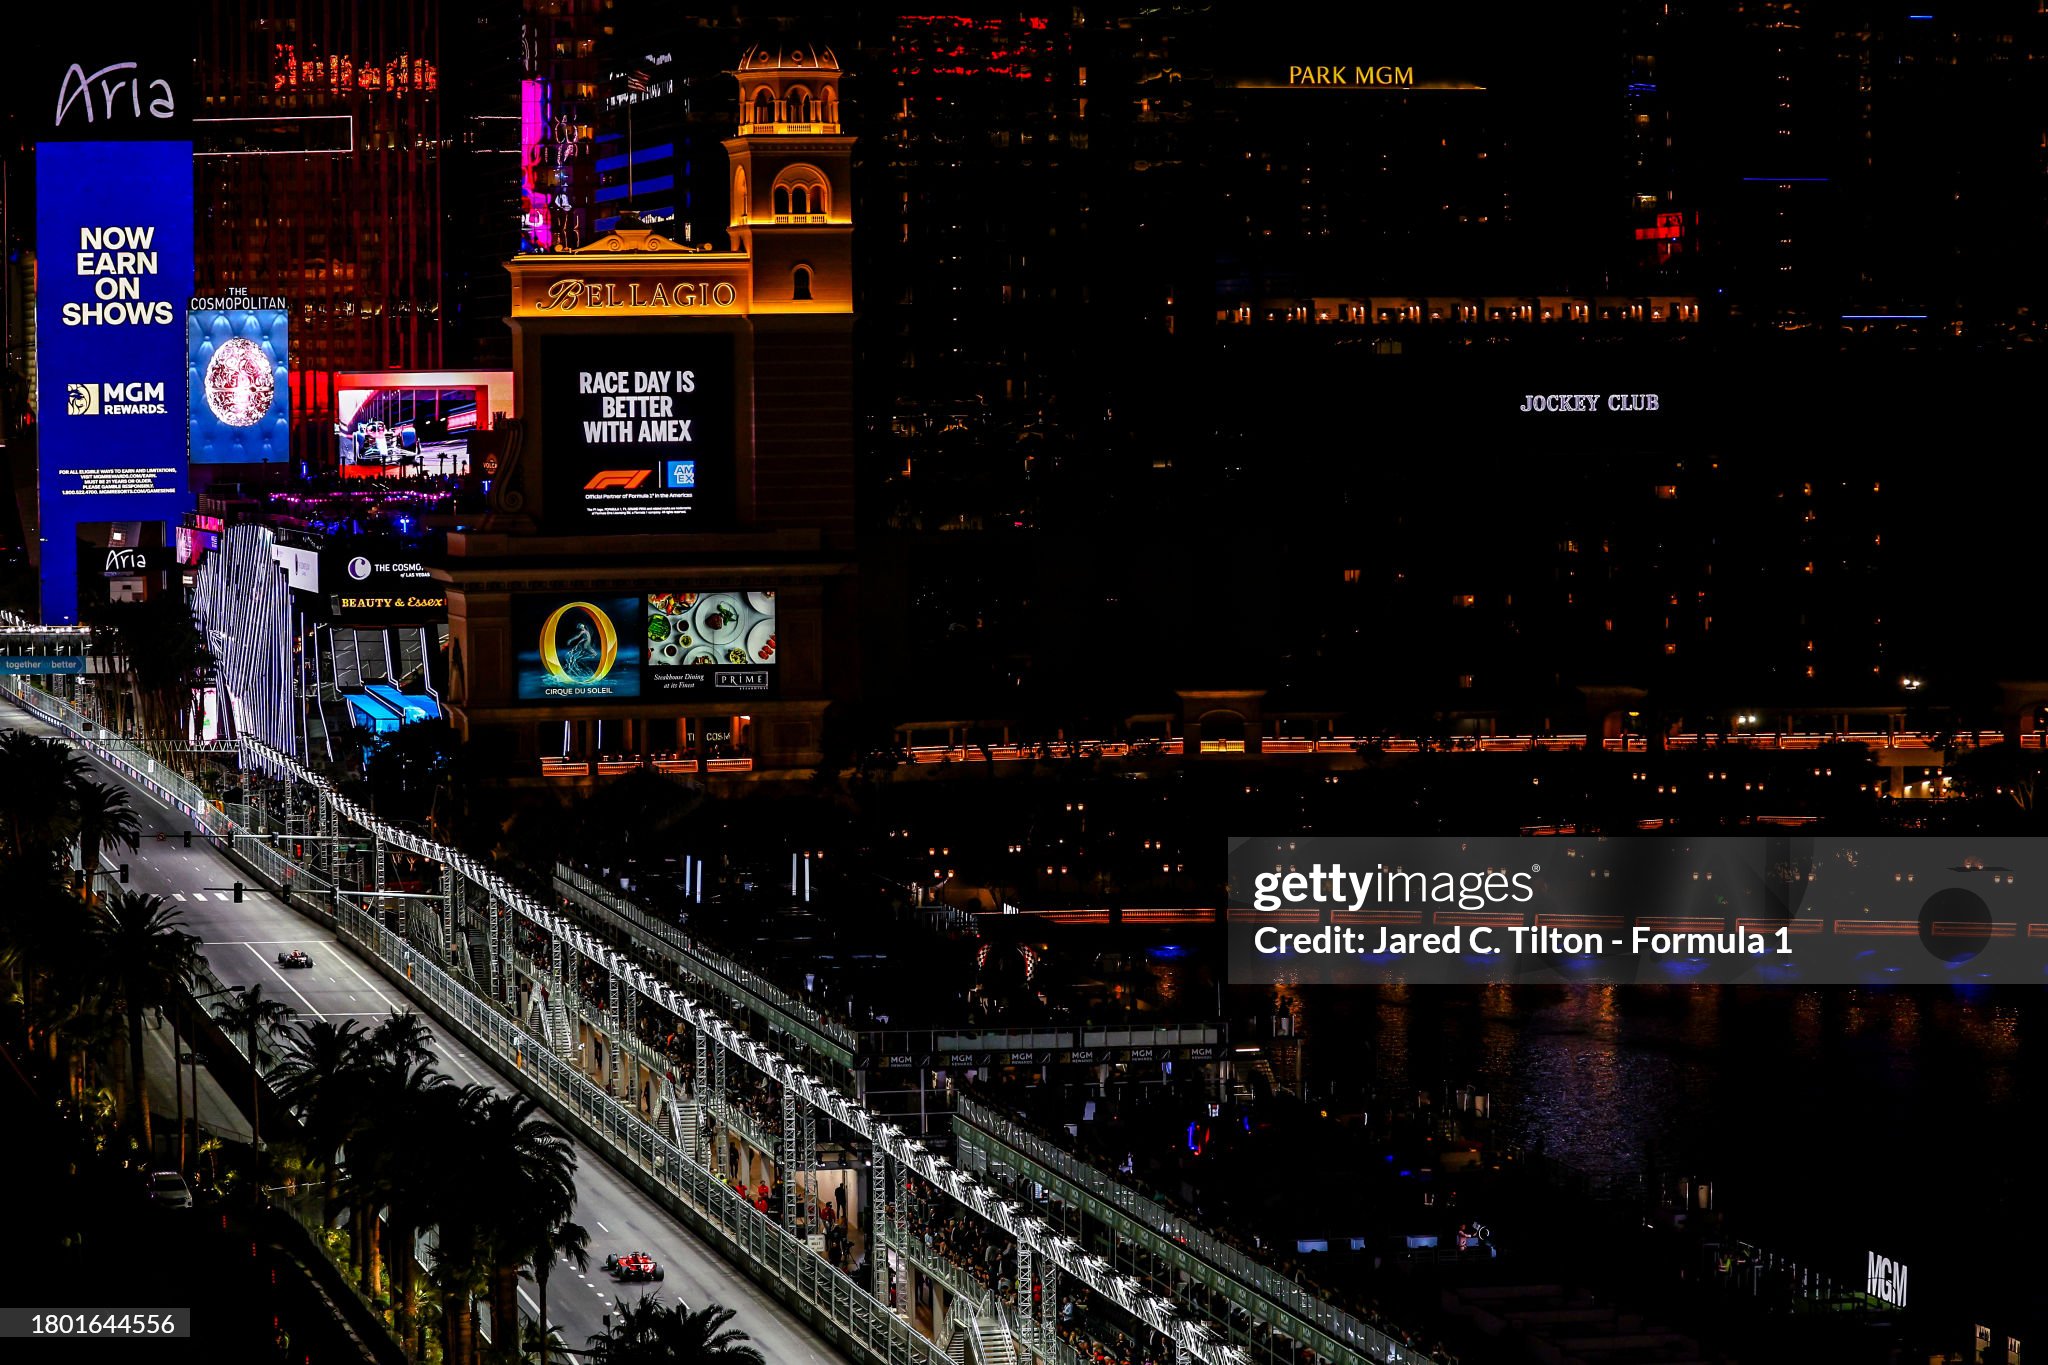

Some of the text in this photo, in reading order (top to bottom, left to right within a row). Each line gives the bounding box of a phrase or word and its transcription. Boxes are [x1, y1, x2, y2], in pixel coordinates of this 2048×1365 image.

[1290, 66, 1414, 85] PARK MGM
[55, 62, 174, 127] Aria
[80, 227, 155, 250] NOW
[77, 252, 158, 275] EARN
[95, 278, 140, 300] ON
[536, 279, 737, 311] BELLAGIO
[62, 301, 173, 326] SHOWS
[191, 297, 286, 310] COSMOPOLITAN
[104, 382, 164, 402] MGM
[579, 371, 695, 394] RACE DAY IS
[602, 396, 673, 418] BETTER
[1520, 394, 1660, 412] JOCKEY CLUB
[584, 420, 692, 443] WITH AMEX
[106, 549, 146, 571] Aria
[342, 597, 443, 607] BEAUTY & Essex
[6, 660, 41, 669] together
[52, 660, 76, 668] better
[721, 673, 763, 685] PRIME
[545, 687, 613, 696] CIRQUE DU SOLEIL
[1867, 1250, 1908, 1308] MGM
